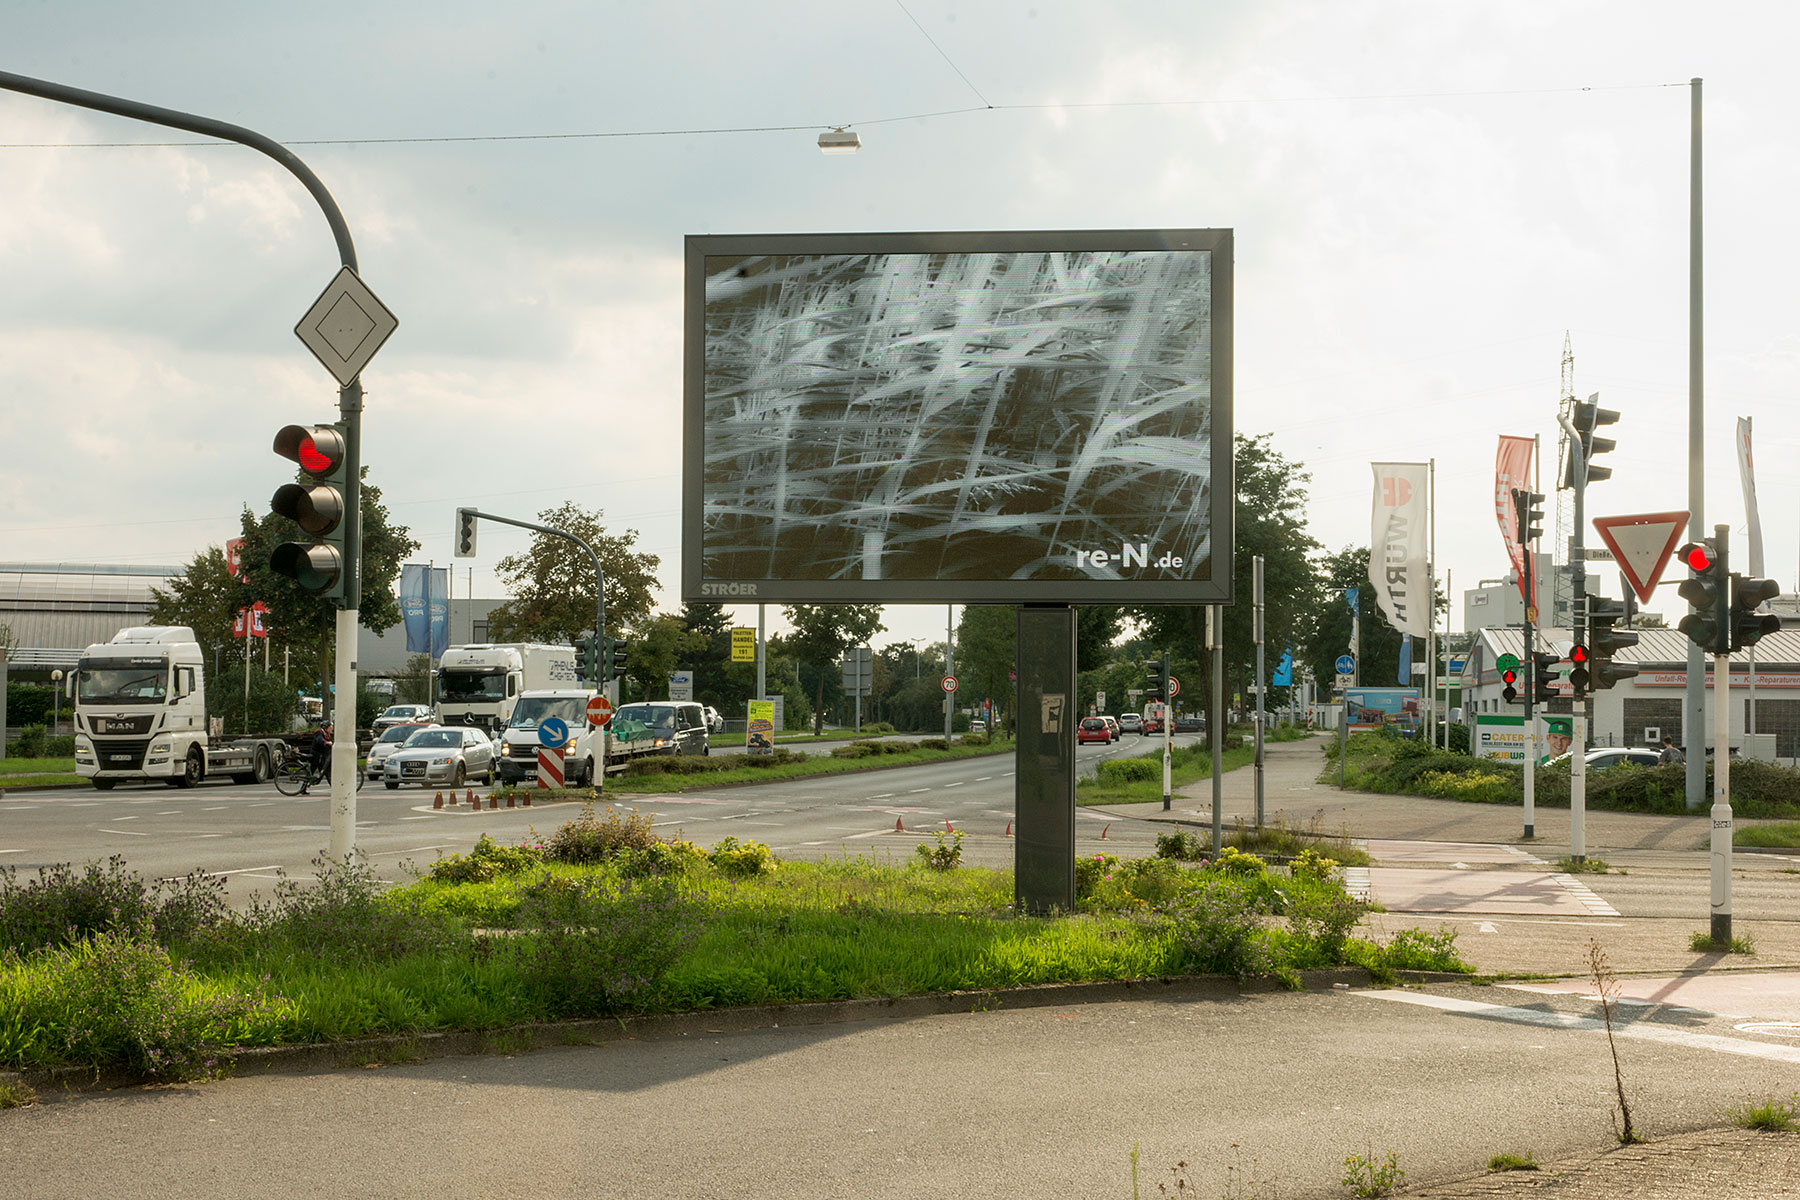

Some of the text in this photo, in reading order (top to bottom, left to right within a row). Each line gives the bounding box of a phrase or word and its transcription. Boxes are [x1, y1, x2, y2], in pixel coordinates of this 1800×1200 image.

[701, 582, 757, 595] STRÖER
[945, 680, 955, 689] 70
[106, 722, 135, 730] MAN
